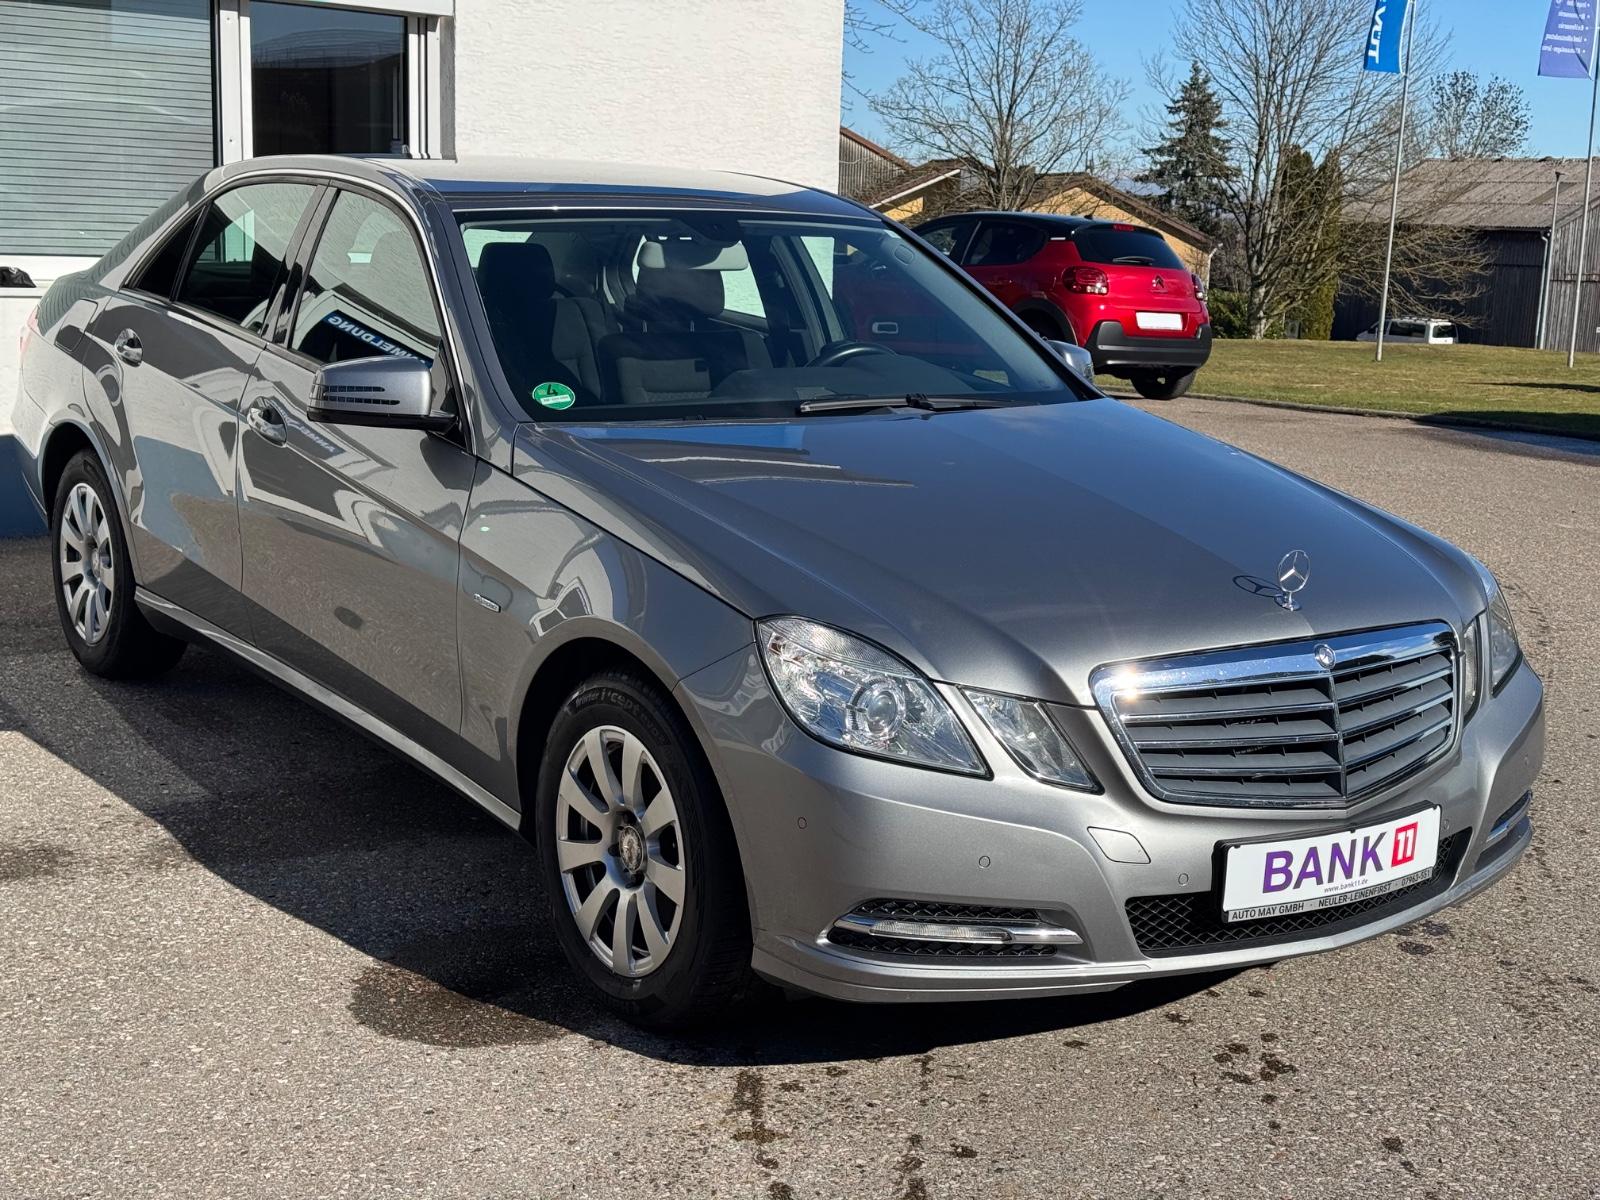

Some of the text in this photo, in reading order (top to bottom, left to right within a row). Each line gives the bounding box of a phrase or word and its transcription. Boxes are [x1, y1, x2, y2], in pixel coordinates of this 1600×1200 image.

[546, 383, 558, 396] 4
[1262, 825, 1416, 894] BANK 11
[1323, 878, 1369, 894] www.bank11.de
[1231, 909, 1256, 920] AUTO
[1257, 906, 1277, 917] MAY
[1278, 902, 1305, 914] GMBH
[1318, 883, 1392, 908] NEULER-LEINENFIRST
